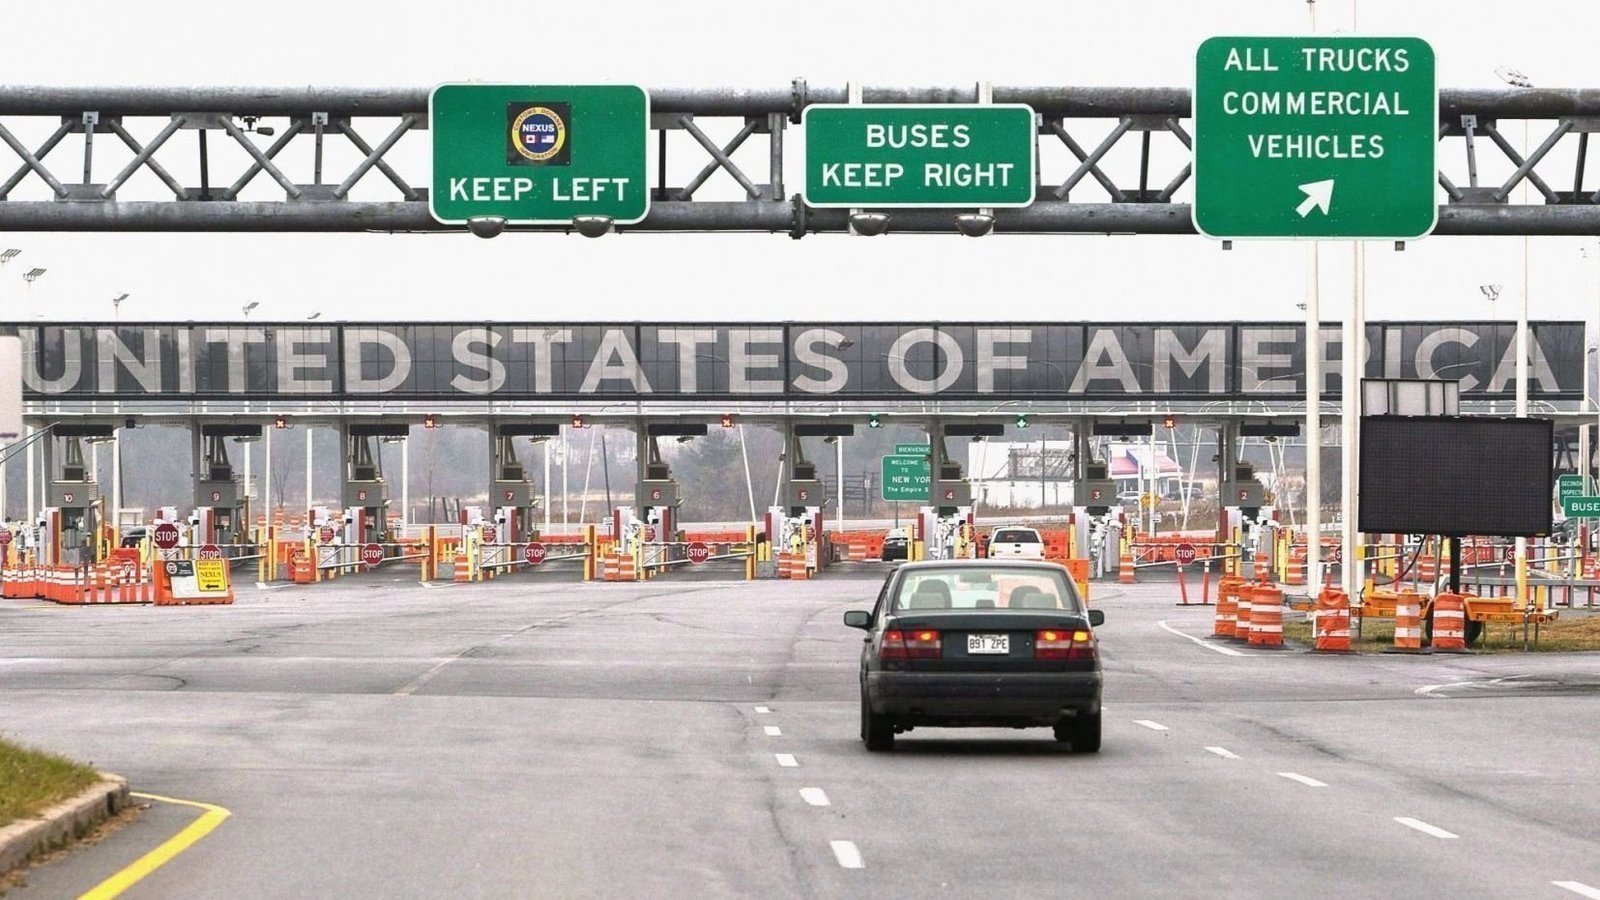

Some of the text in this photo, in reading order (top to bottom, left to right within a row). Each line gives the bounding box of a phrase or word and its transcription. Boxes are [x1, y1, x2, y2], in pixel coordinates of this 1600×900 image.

[1224, 48, 1409, 72] ALL TRUCKS
[1223, 91, 1409, 115] COMMERCIAL
[522, 124, 555, 132] NEXUS
[866, 124, 971, 149] BUSES
[1248, 134, 1384, 158] VEHICLES
[822, 163, 1014, 187] KEEP RIGHT
[450, 178, 630, 201] KEEP LEFT
[17, 328, 1561, 394] UNITED STATES OF AMERICA
[64, 494, 73, 502] 10
[213, 492, 220, 501] 9
[507, 492, 513, 500] 7
[653, 491, 660, 499] 6
[801, 491, 807, 499] 5
[946, 491, 953, 499] 4
[1094, 491, 1100, 499] 3
[1241, 492, 1248, 500] 2
[1571, 503, 1600, 511] BUSE
[155, 531, 178, 541] STOP
[200, 551, 219, 560] STOP
[363, 550, 383, 558] STOP
[525, 549, 545, 558] STOP
[688, 548, 708, 557] STOP
[1176, 550, 1195, 558] STOP
[991, 638, 1007, 649] ZPE
